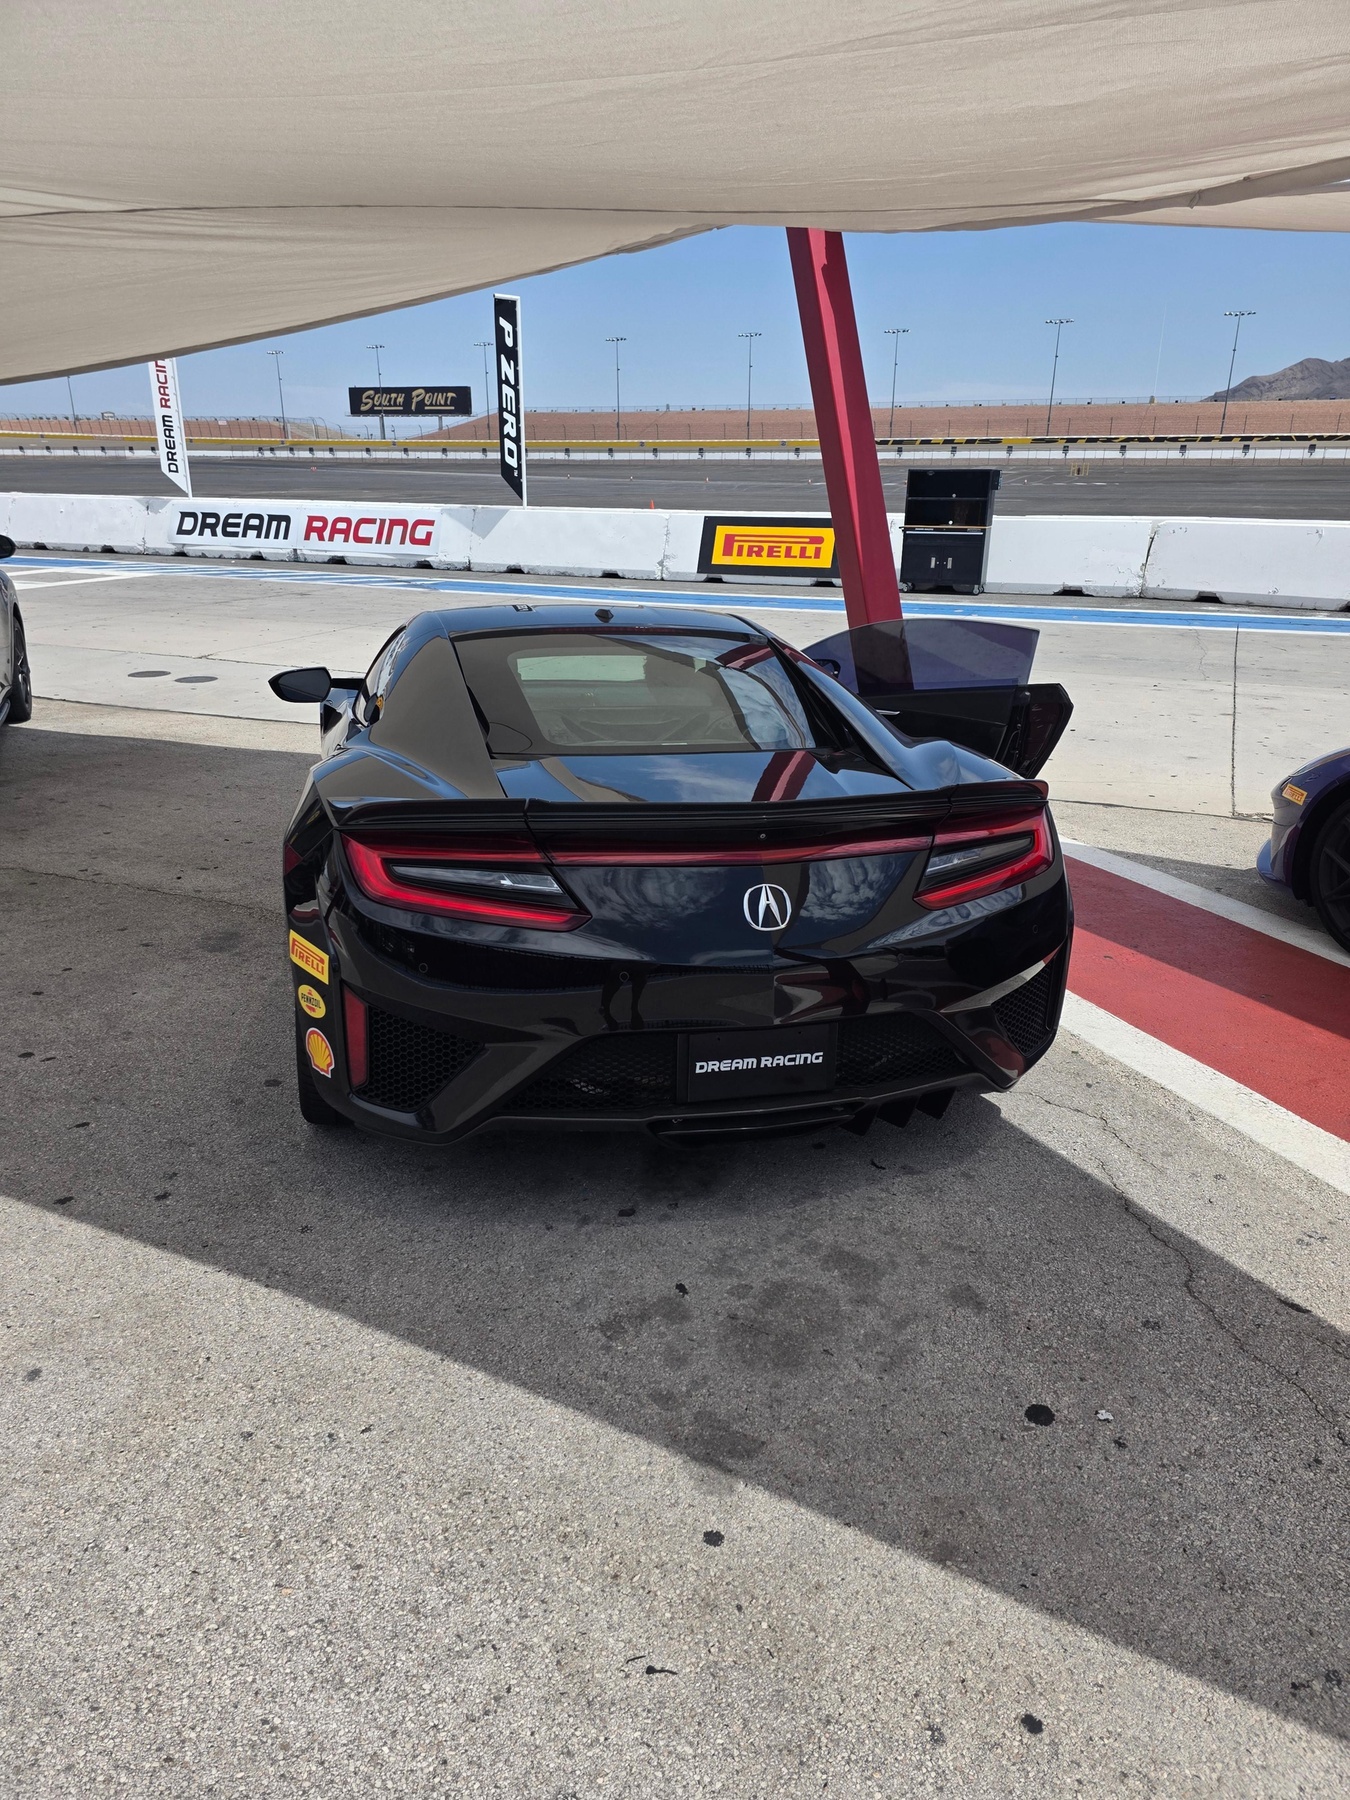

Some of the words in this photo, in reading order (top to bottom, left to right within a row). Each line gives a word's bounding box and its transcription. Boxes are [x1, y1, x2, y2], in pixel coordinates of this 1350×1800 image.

[499, 316, 514, 348] P
[154, 359, 171, 409] RACIN
[360, 390, 405, 411] SOUTH
[411, 388, 457, 412] POINT
[501, 354, 518, 470] ZERO
[162, 414, 179, 473] DREAM
[176, 511, 292, 540] DREAM
[304, 514, 435, 546] RACING
[722, 533, 825, 559] PIRELLI
[291, 938, 325, 975] PIRELLI
[300, 992, 322, 1009] PENNZOIL
[695, 1057, 757, 1073] DREAM
[760, 1052, 823, 1067] RACING
